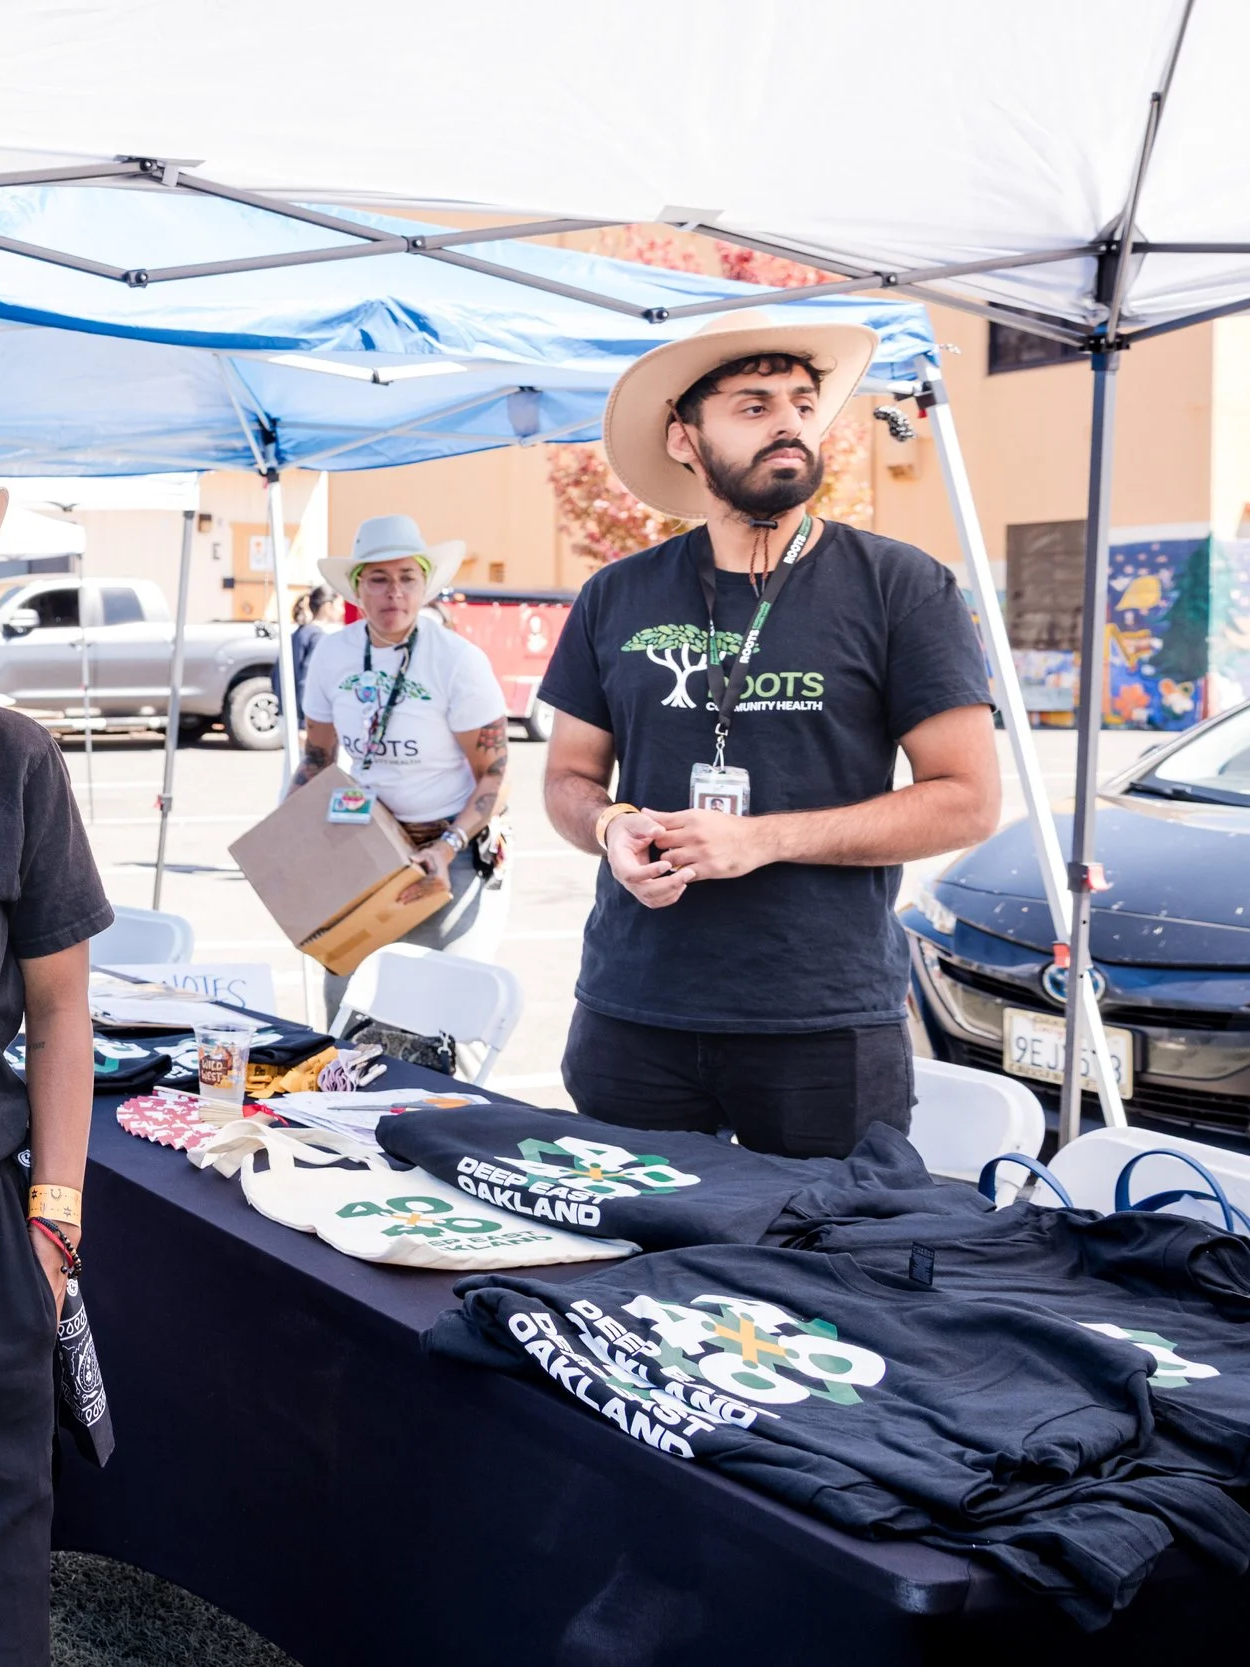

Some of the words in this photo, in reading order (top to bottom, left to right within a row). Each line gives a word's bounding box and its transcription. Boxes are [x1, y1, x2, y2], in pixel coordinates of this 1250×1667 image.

[783, 533, 806, 564] ROOTS
[739, 629, 760, 664] ROOTS
[705, 701, 775, 712] CMUNITY
[776, 701, 823, 711] HEALTH
[202, 1059, 223, 1070] WILD
[202, 1070, 223, 1082] WEST
[457, 1156, 529, 1188] DEEP
[528, 1181, 617, 1205] EAST
[457, 1174, 601, 1227] OAKLAND
[428, 1238, 461, 1247] EP
[467, 1230, 535, 1243] EAST
[570, 1300, 662, 1357] DEEP
[507, 1312, 695, 1459] OAKLAND
